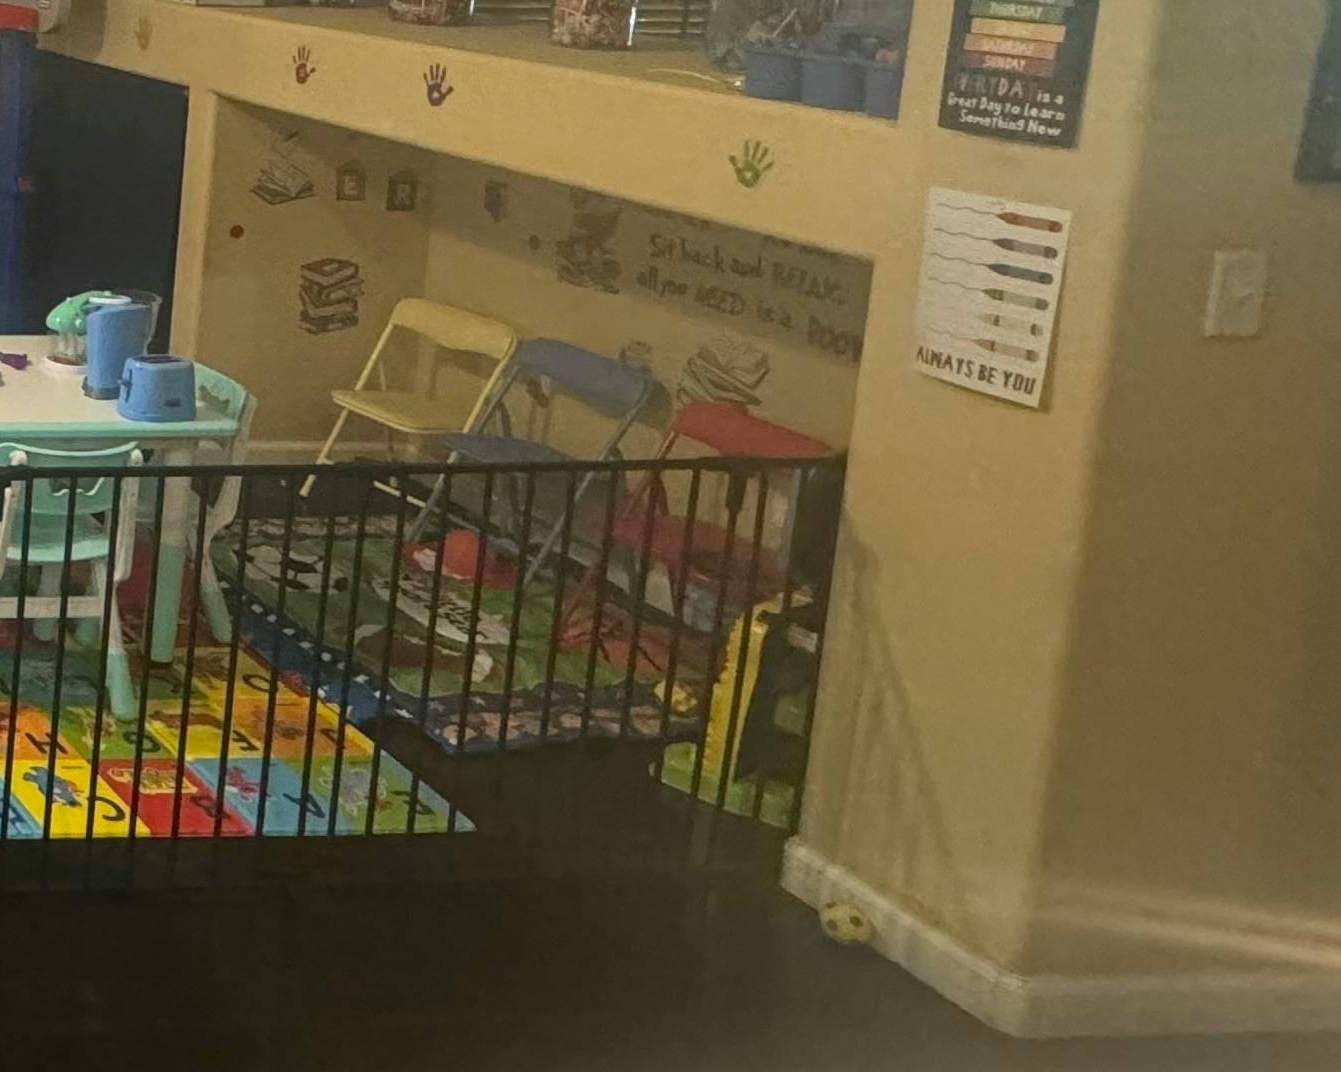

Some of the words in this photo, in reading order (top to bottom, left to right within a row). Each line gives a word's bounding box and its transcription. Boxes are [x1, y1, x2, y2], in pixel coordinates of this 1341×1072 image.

[989, 1, 1043, 19] THURSDAY
[947, 92, 977, 109] Great
[979, 97, 1001, 115] Day
[1004, 102, 1018, 114] to
[1024, 103, 1066, 121] Learn
[1037, 90, 1050, 103] is
[959, 109, 1026, 131] Something
[1027, 118, 1062, 137] New
[917, 344, 974, 379] ALWAYS
[977, 364, 997, 385] BE
[1003, 370, 1038, 396] YOU
[24, 732, 68, 755] H
